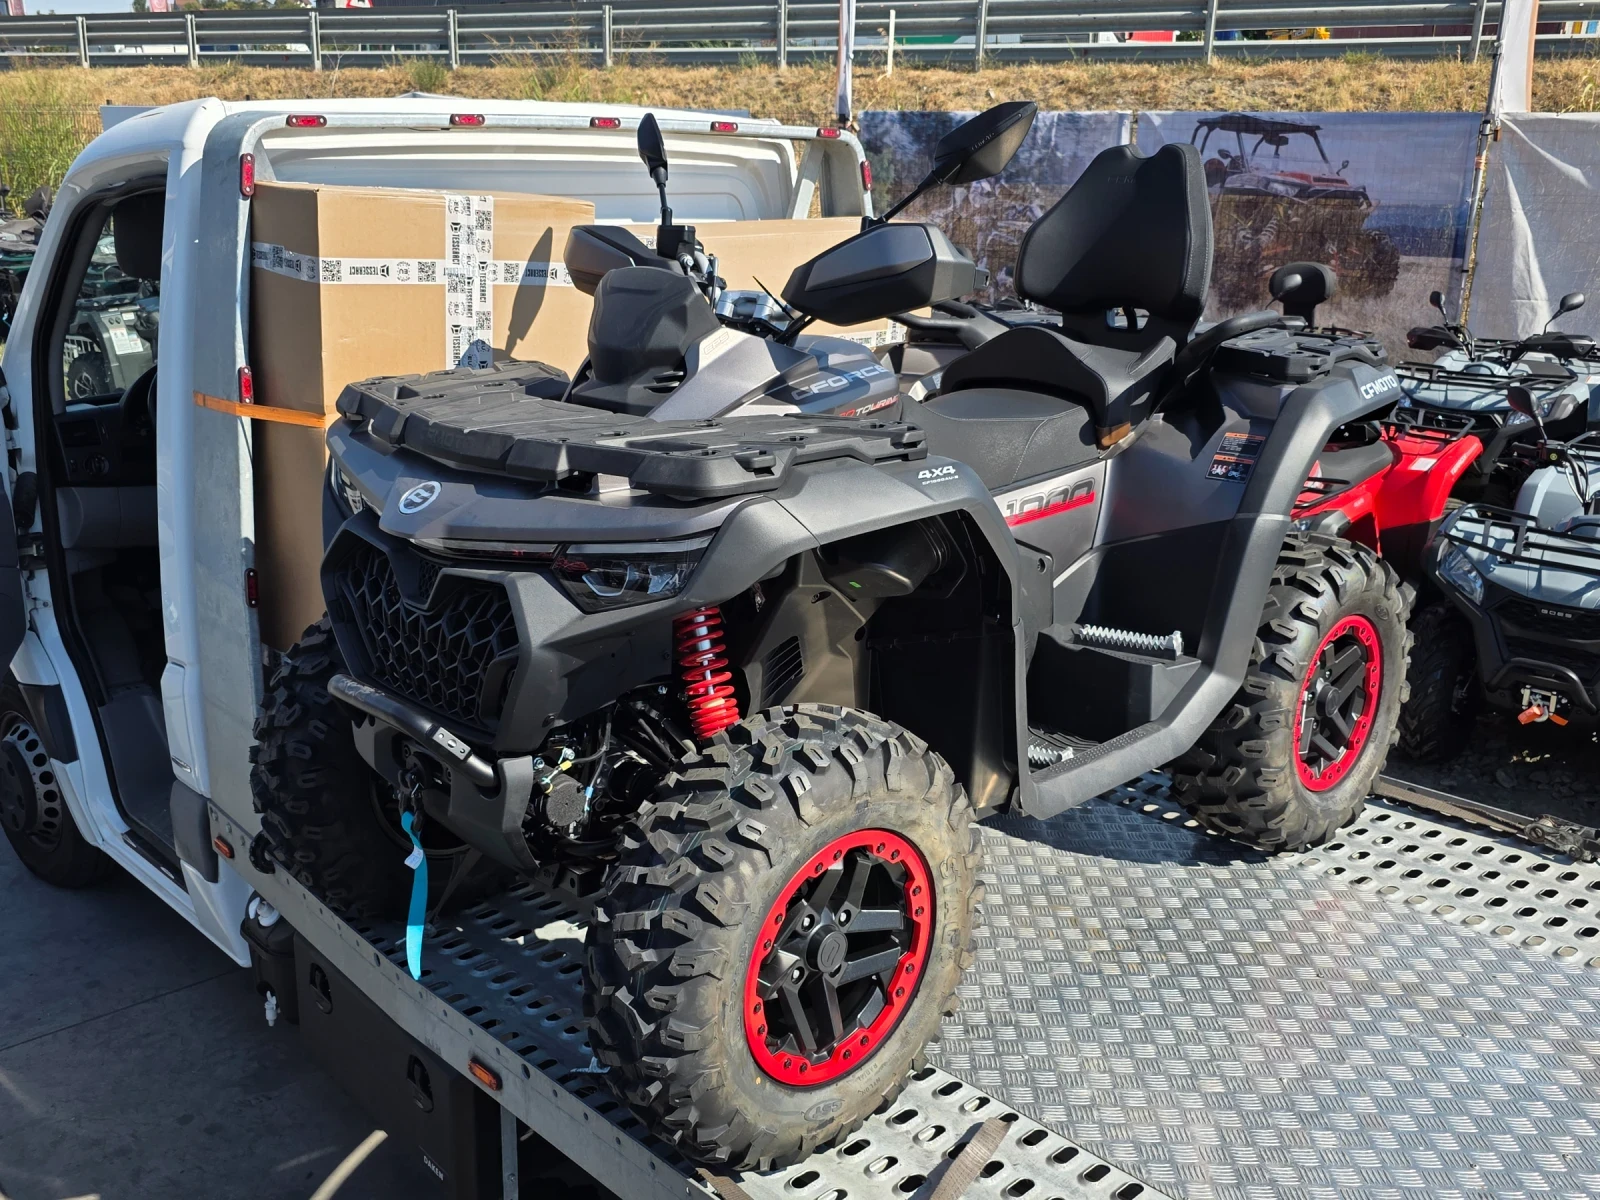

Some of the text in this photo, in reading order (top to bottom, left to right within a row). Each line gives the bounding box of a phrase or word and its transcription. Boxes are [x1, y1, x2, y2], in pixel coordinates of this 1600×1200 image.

[452, 234, 460, 265] TESSERACT
[349, 265, 379, 276] TESSERACT
[525, 268, 548, 278] TESSERACT
[453, 335, 461, 366] TESSERACT
[791, 365, 889, 401] CFORCE
[1360, 375, 1398, 400] CFMOTO
[1006, 477, 1096, 518] 1000
